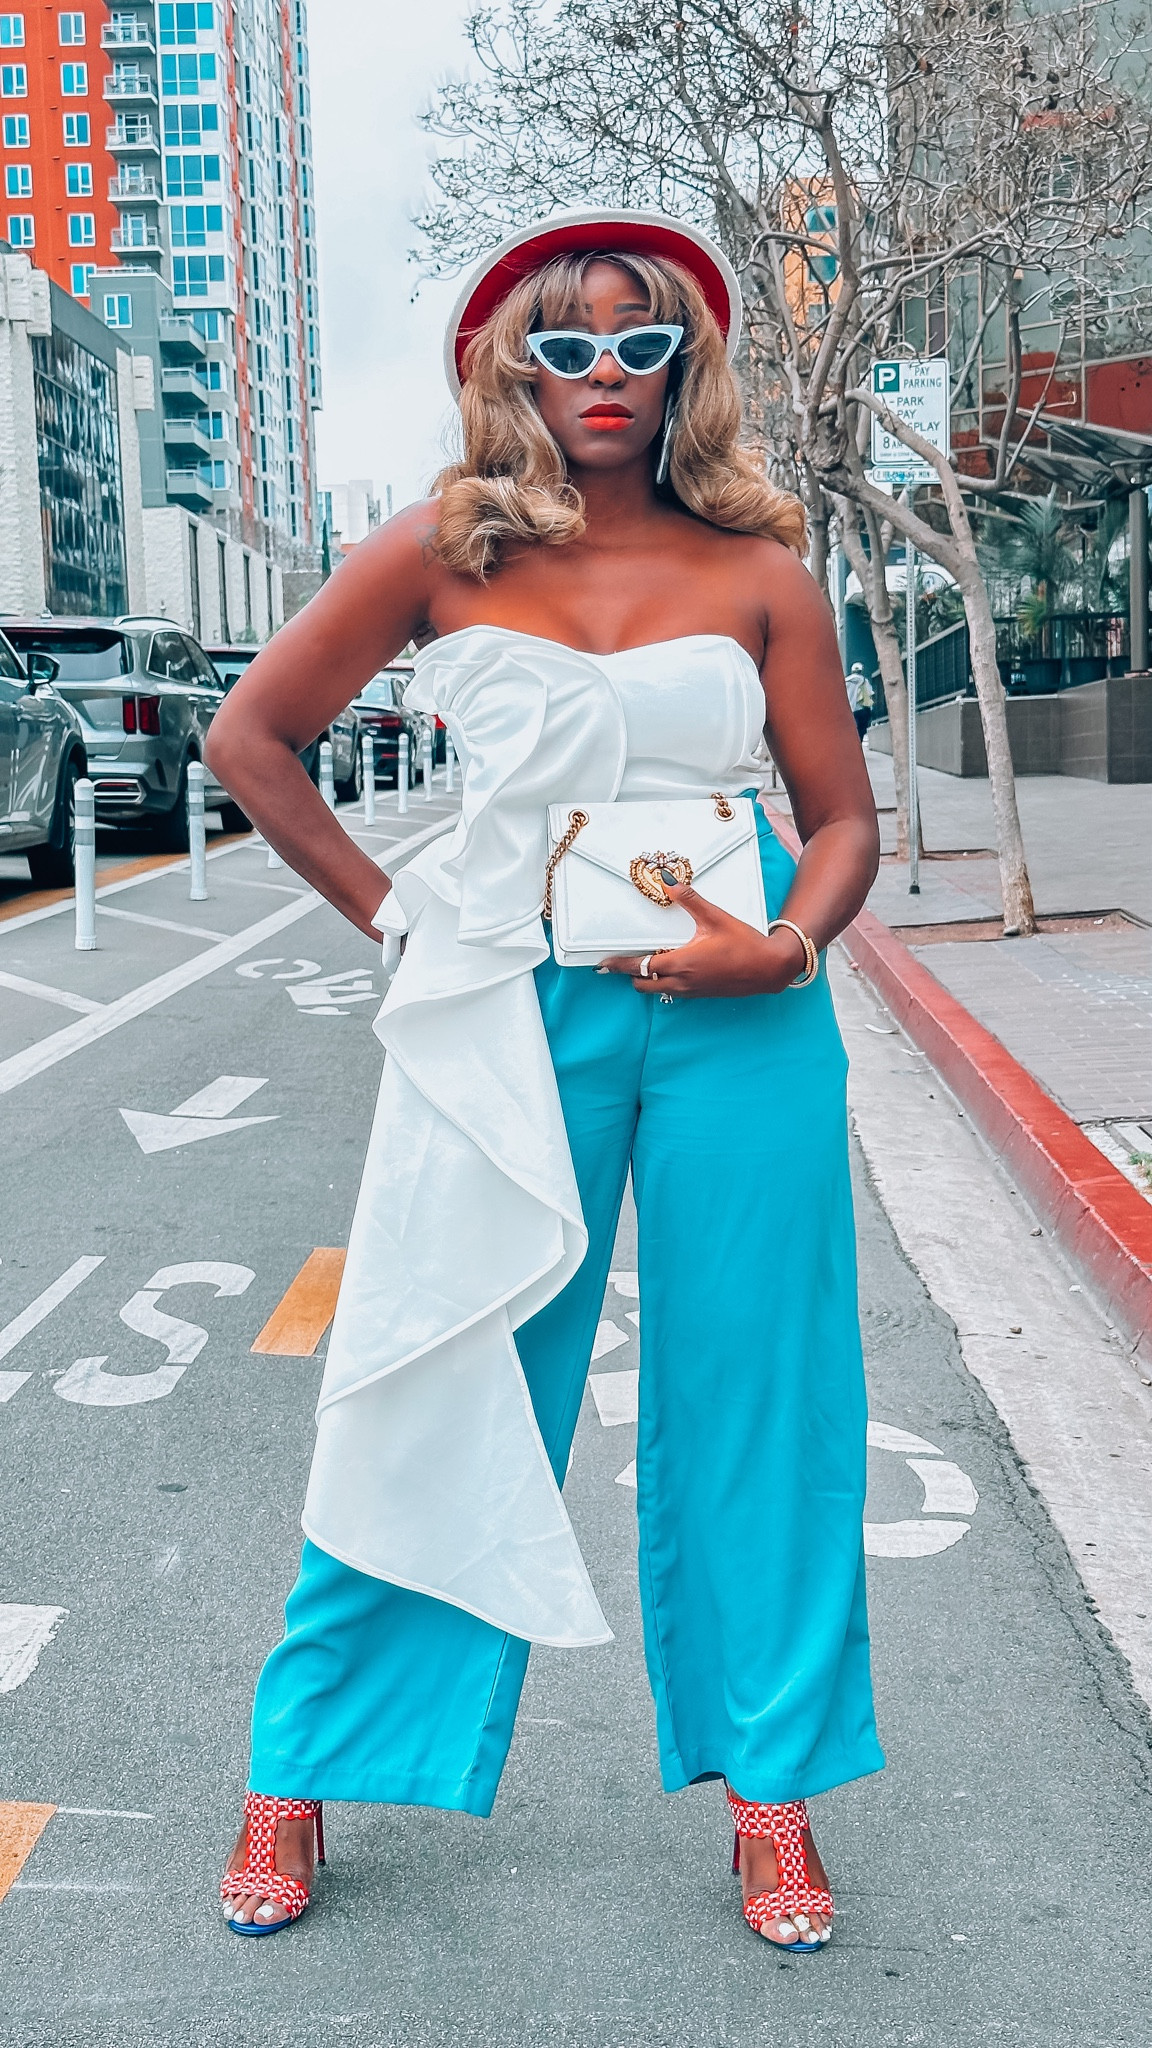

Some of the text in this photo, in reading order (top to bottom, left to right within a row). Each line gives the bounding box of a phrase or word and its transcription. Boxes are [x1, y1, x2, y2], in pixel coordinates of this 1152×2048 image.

[914, 367, 930, 376] PAY
[878, 367, 897, 390] P
[903, 378, 942, 388] PARKING
[908, 420, 941, 432] SPLAY
